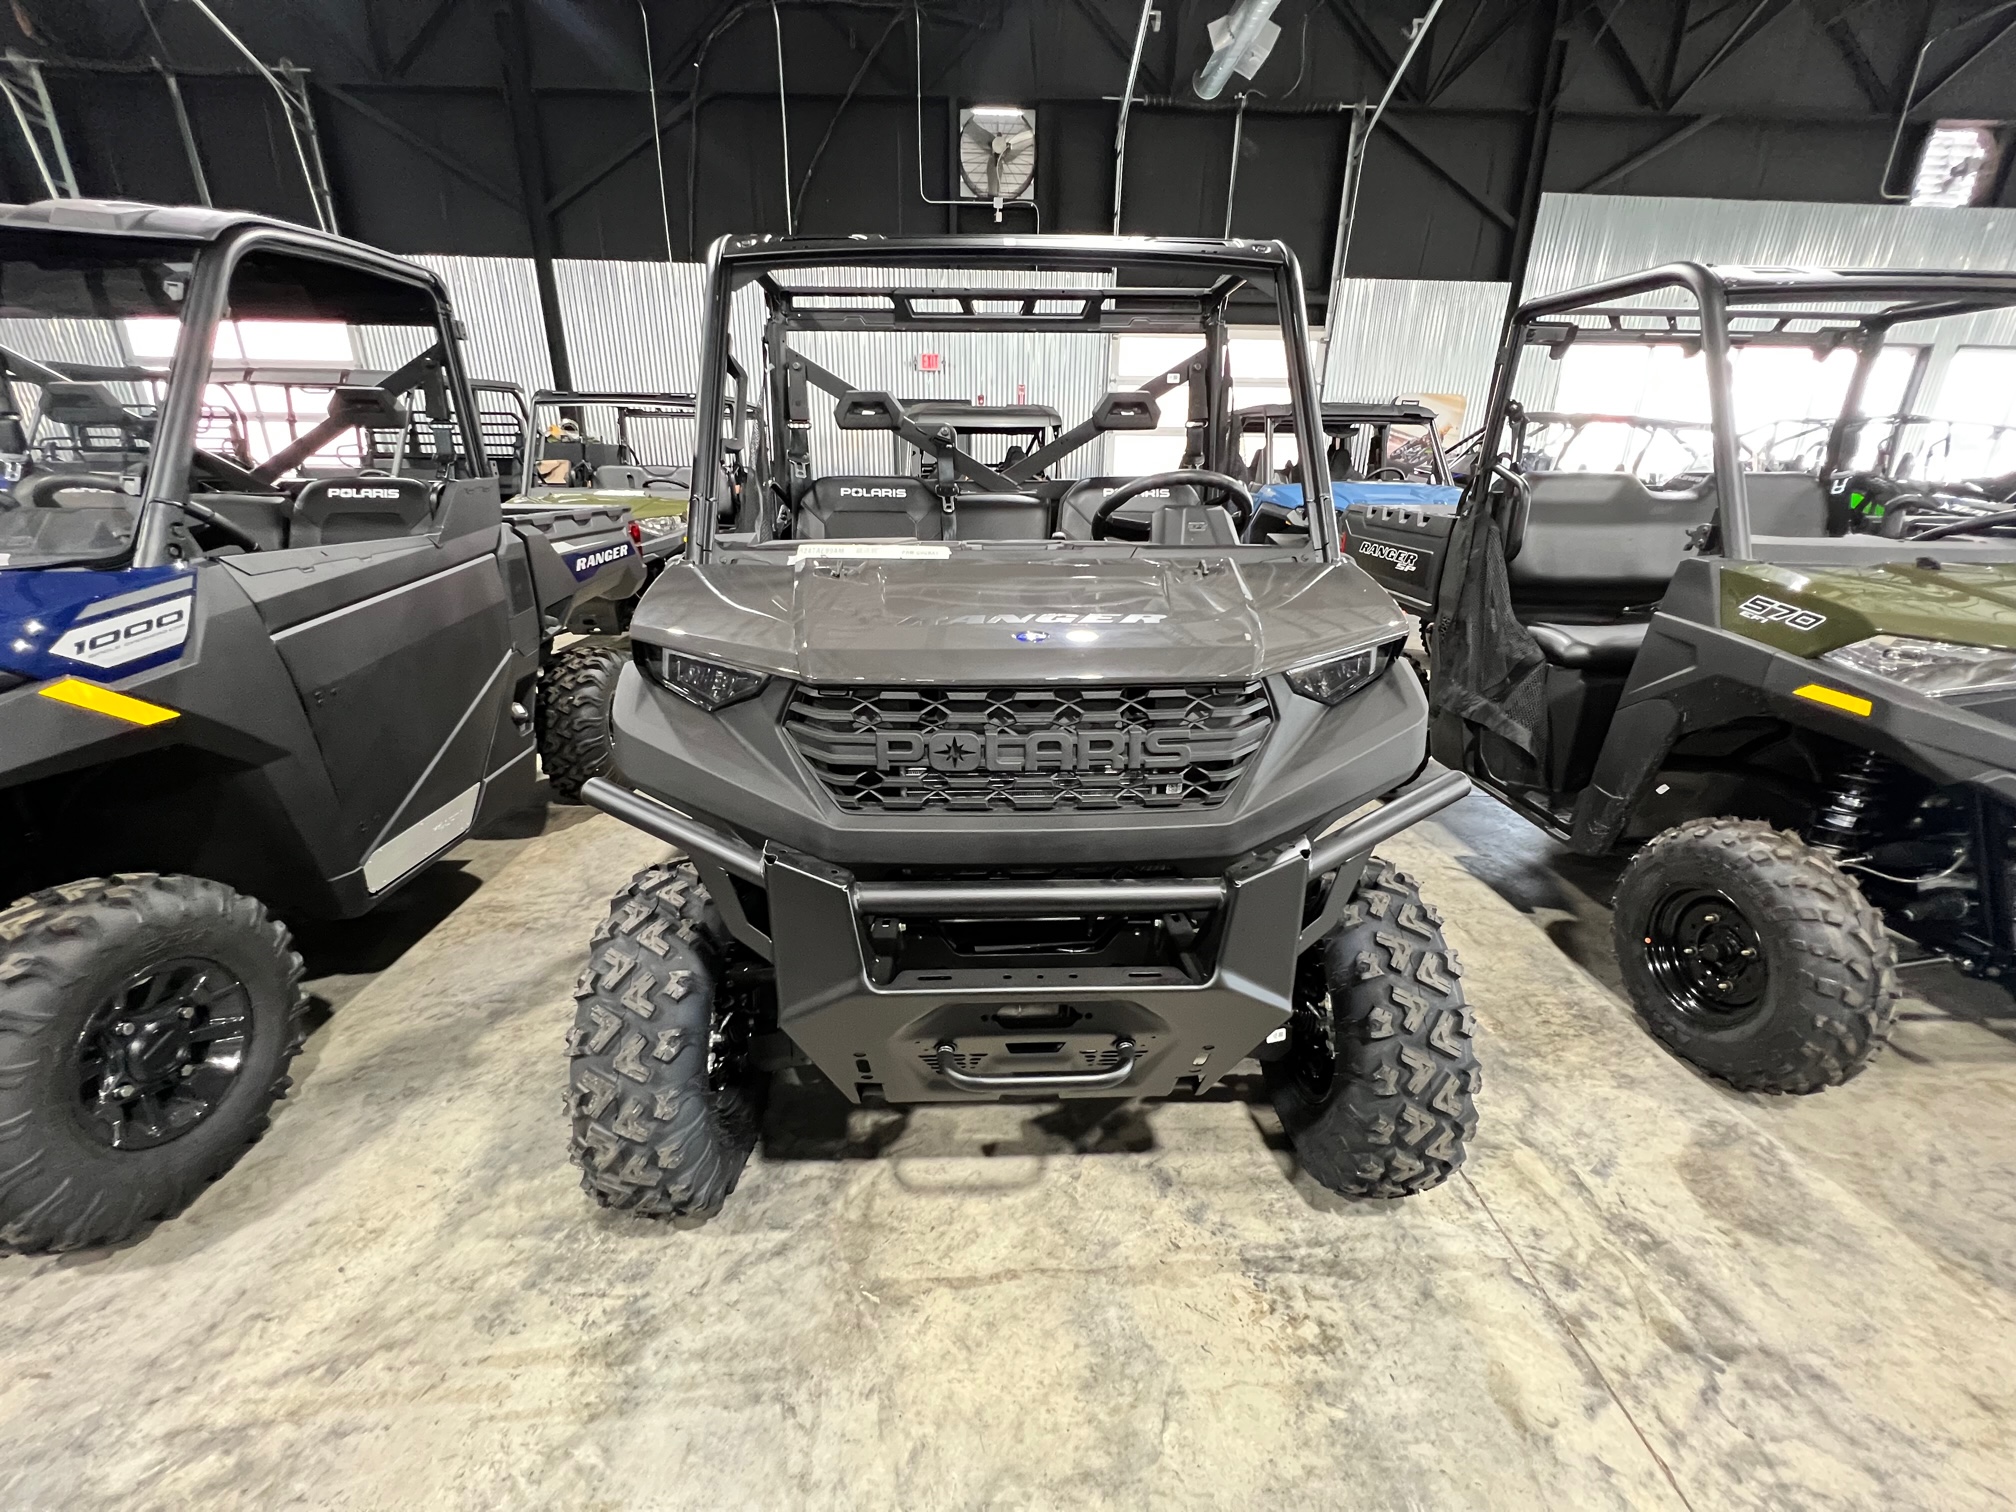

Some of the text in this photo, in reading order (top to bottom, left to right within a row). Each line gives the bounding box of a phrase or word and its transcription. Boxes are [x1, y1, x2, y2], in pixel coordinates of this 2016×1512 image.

[921, 354, 939, 369] EXIT
[327, 488, 400, 499] POLARIS
[840, 487, 907, 498] POLARIS
[575, 544, 629, 572] RANGER
[1358, 541, 1419, 567] RANGER
[1394, 562, 1417, 572] SP
[1738, 594, 1828, 631] 570
[1738, 610, 1769, 624] EFI
[73, 609, 184, 656] 1000
[875, 729, 1192, 772] POLARIS
